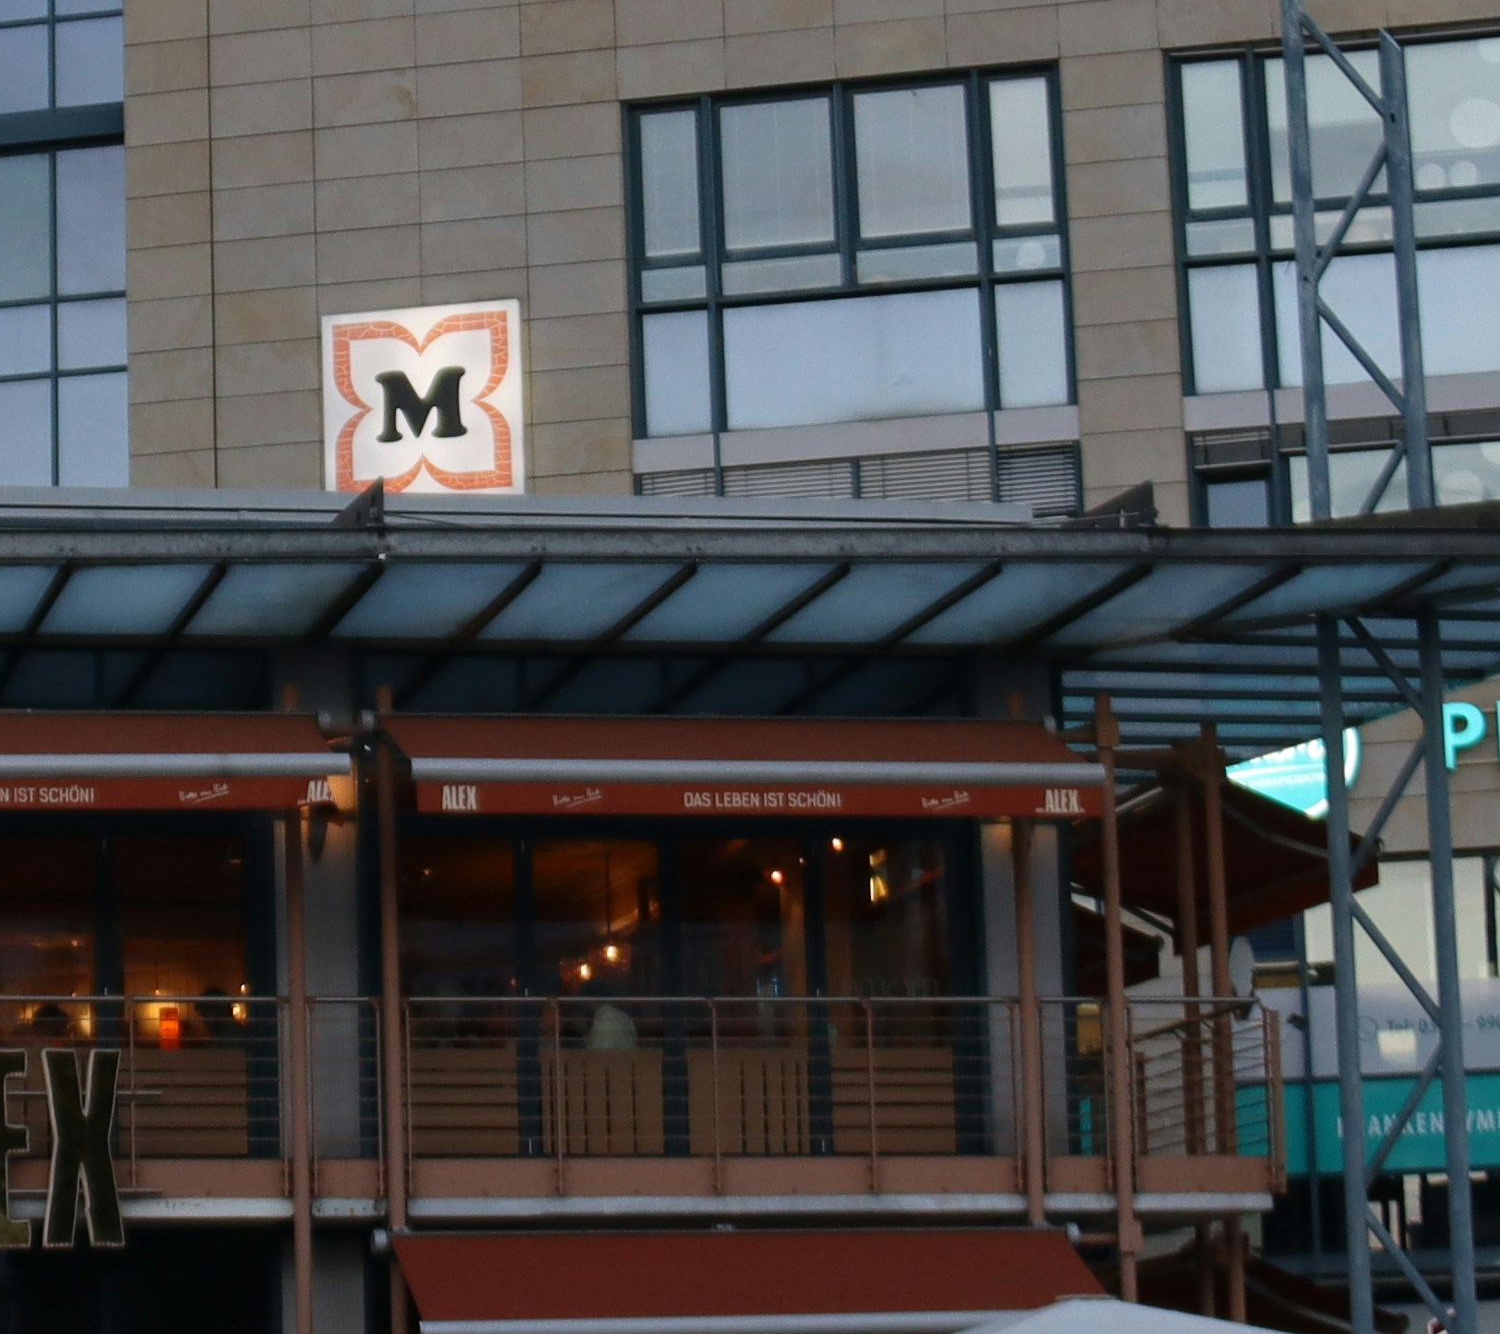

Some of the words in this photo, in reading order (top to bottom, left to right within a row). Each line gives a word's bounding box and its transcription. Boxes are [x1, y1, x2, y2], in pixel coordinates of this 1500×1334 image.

[376, 365, 468, 444] M
[13, 787, 36, 803] IST
[39, 784, 95, 803] SCHÖN!
[442, 785, 477, 810] ALEX
[683, 791, 712, 808] DAS
[715, 791, 760, 808] LEBEN
[763, 792, 784, 808] IST
[787, 789, 841, 808] SCHÖN!
